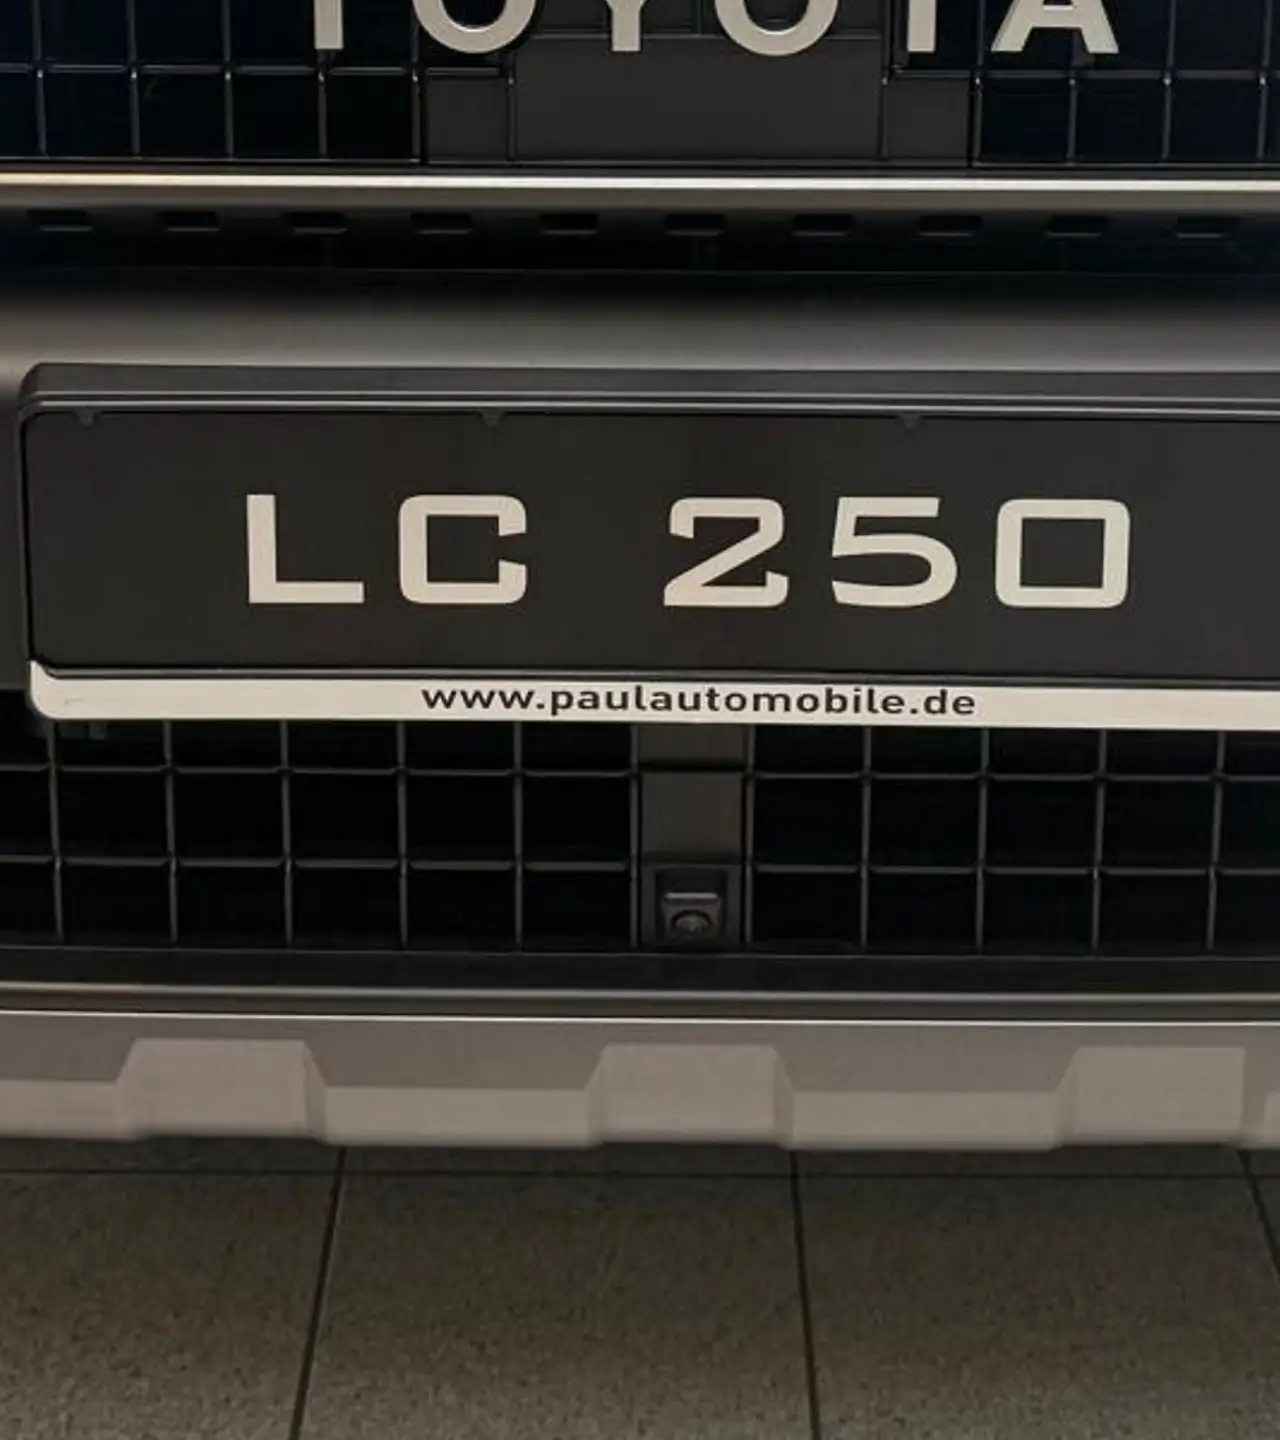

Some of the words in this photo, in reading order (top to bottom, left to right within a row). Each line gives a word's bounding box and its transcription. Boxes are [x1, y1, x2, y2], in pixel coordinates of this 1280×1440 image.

[246, 494, 527, 604] LC
[663, 496, 1131, 609] 250
[420, 684, 976, 716] www.paulautomobile.de
